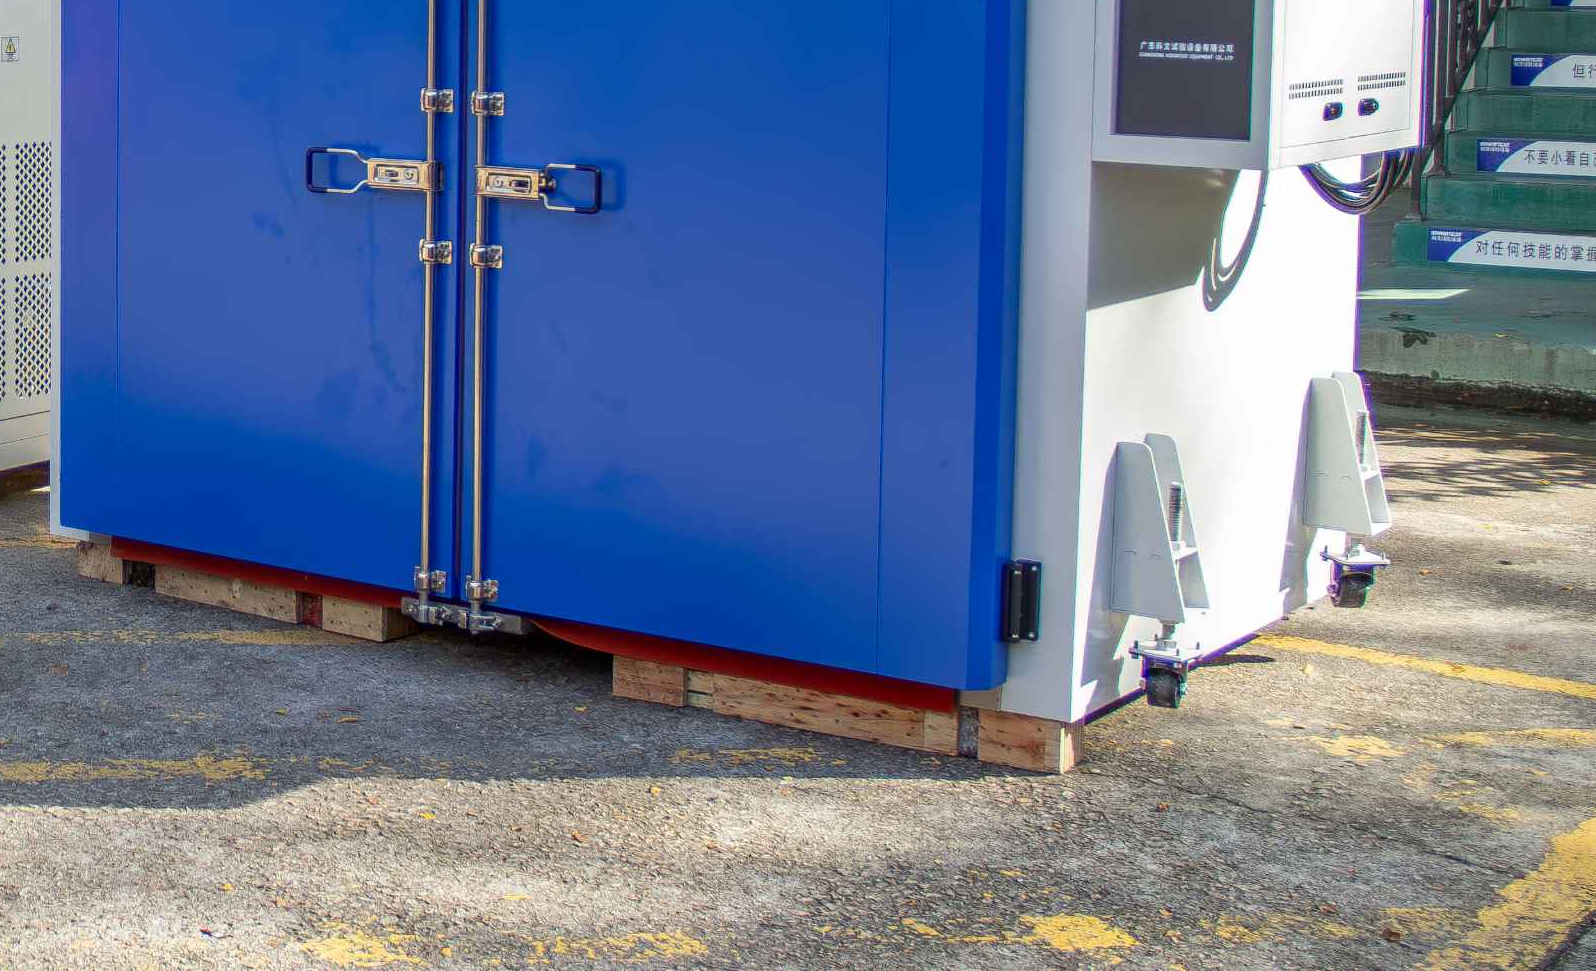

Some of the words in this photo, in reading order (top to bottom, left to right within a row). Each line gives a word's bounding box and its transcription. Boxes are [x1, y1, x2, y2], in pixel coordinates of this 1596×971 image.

[1523, 149, 1596, 168] 不要小看自
[1475, 240, 1596, 263] 对任何技能的掌握
